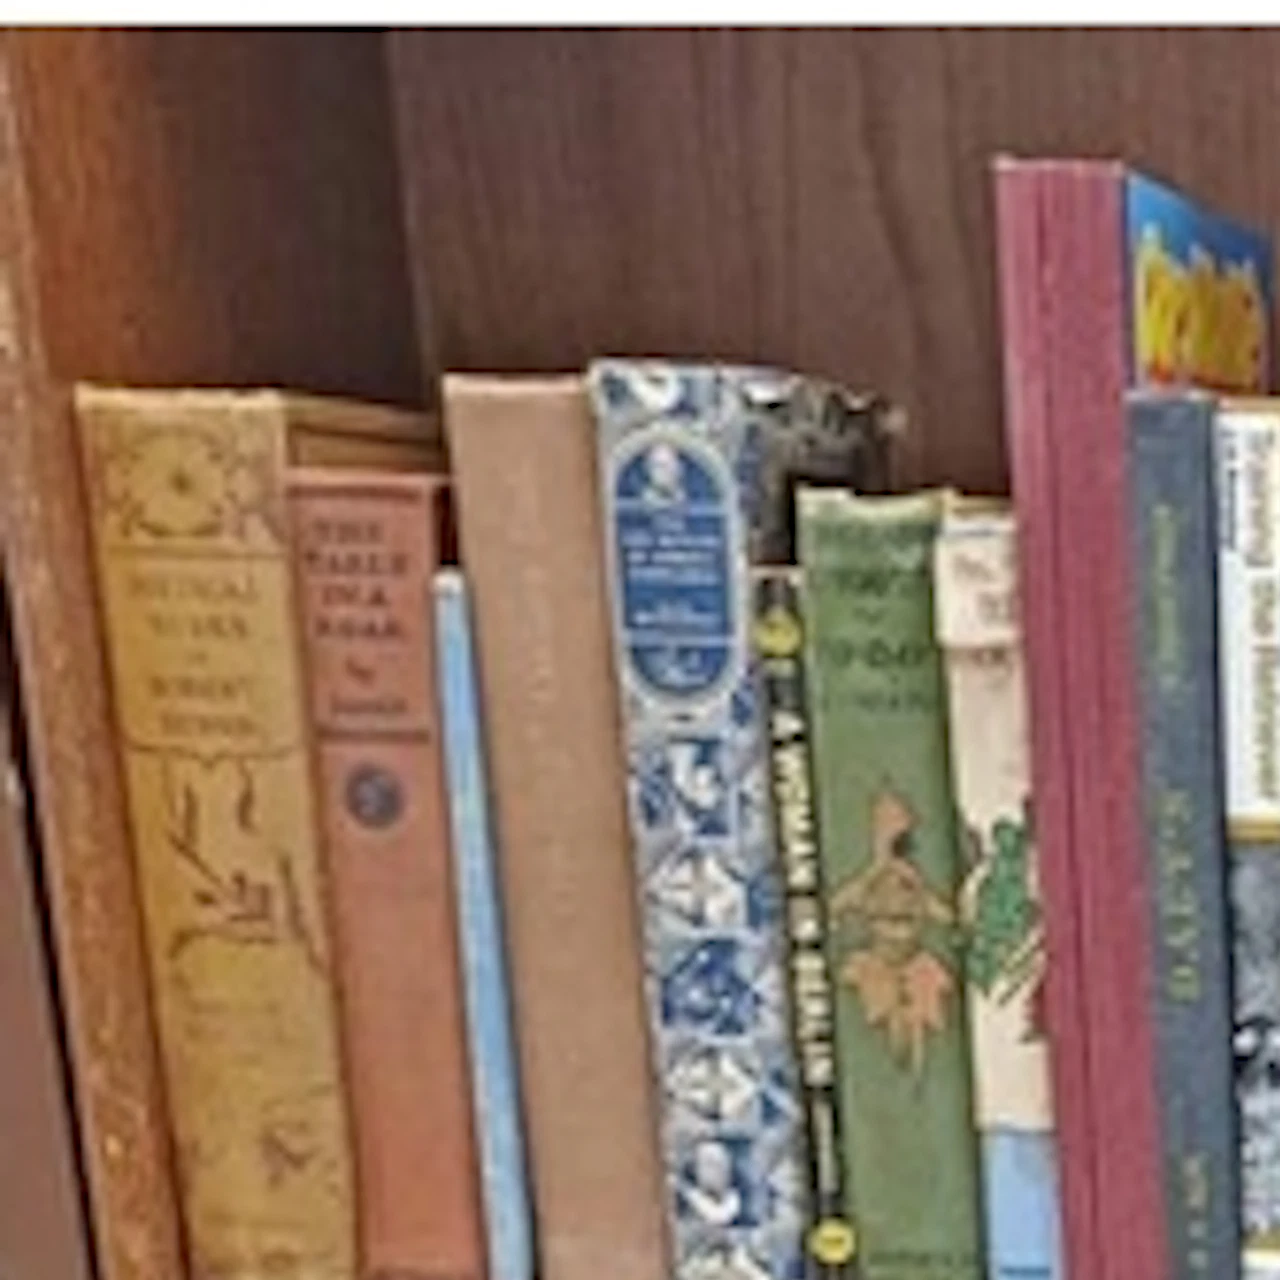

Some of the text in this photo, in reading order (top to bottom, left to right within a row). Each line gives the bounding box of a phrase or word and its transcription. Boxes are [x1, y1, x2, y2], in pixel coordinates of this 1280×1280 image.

[1242, 428, 1276, 568] Training
[1248, 575, 1277, 639] the
[770, 709, 806, 738] A
[774, 746, 822, 891] WOMAN
[792, 952, 836, 1087] BERLIN
